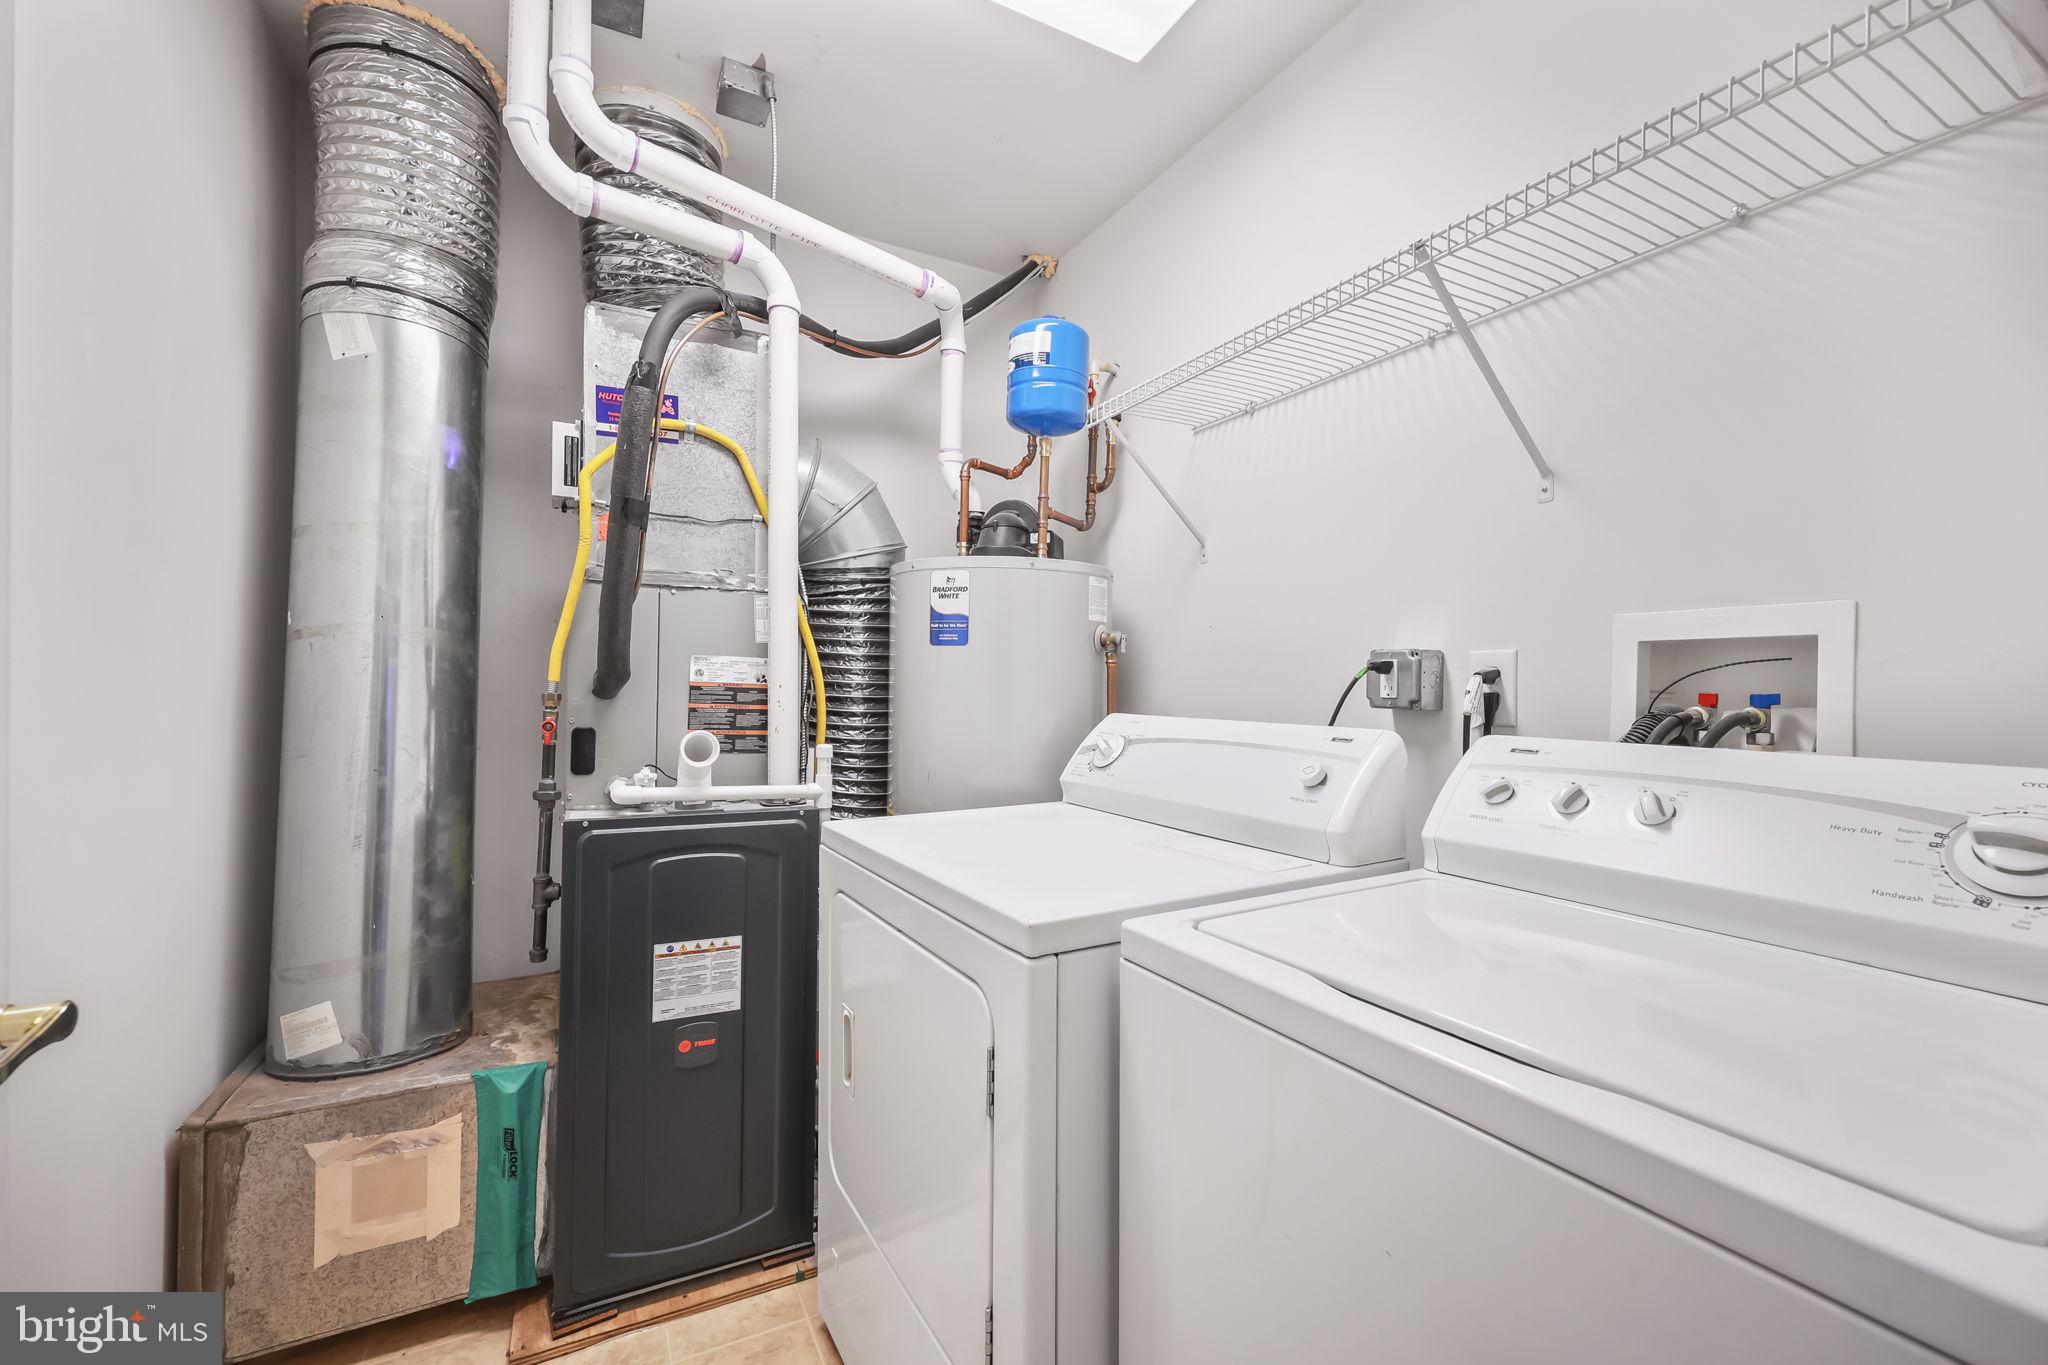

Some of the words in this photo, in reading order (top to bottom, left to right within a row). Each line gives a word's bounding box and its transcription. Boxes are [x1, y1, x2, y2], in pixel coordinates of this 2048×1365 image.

[706, 194, 784, 233] CHARLOTTE
[790, 232, 824, 250] PIPE
[1828, 824, 1858, 834] Heavy
[1860, 827, 1884, 837] Duty
[1871, 888, 1924, 903] Handwash
